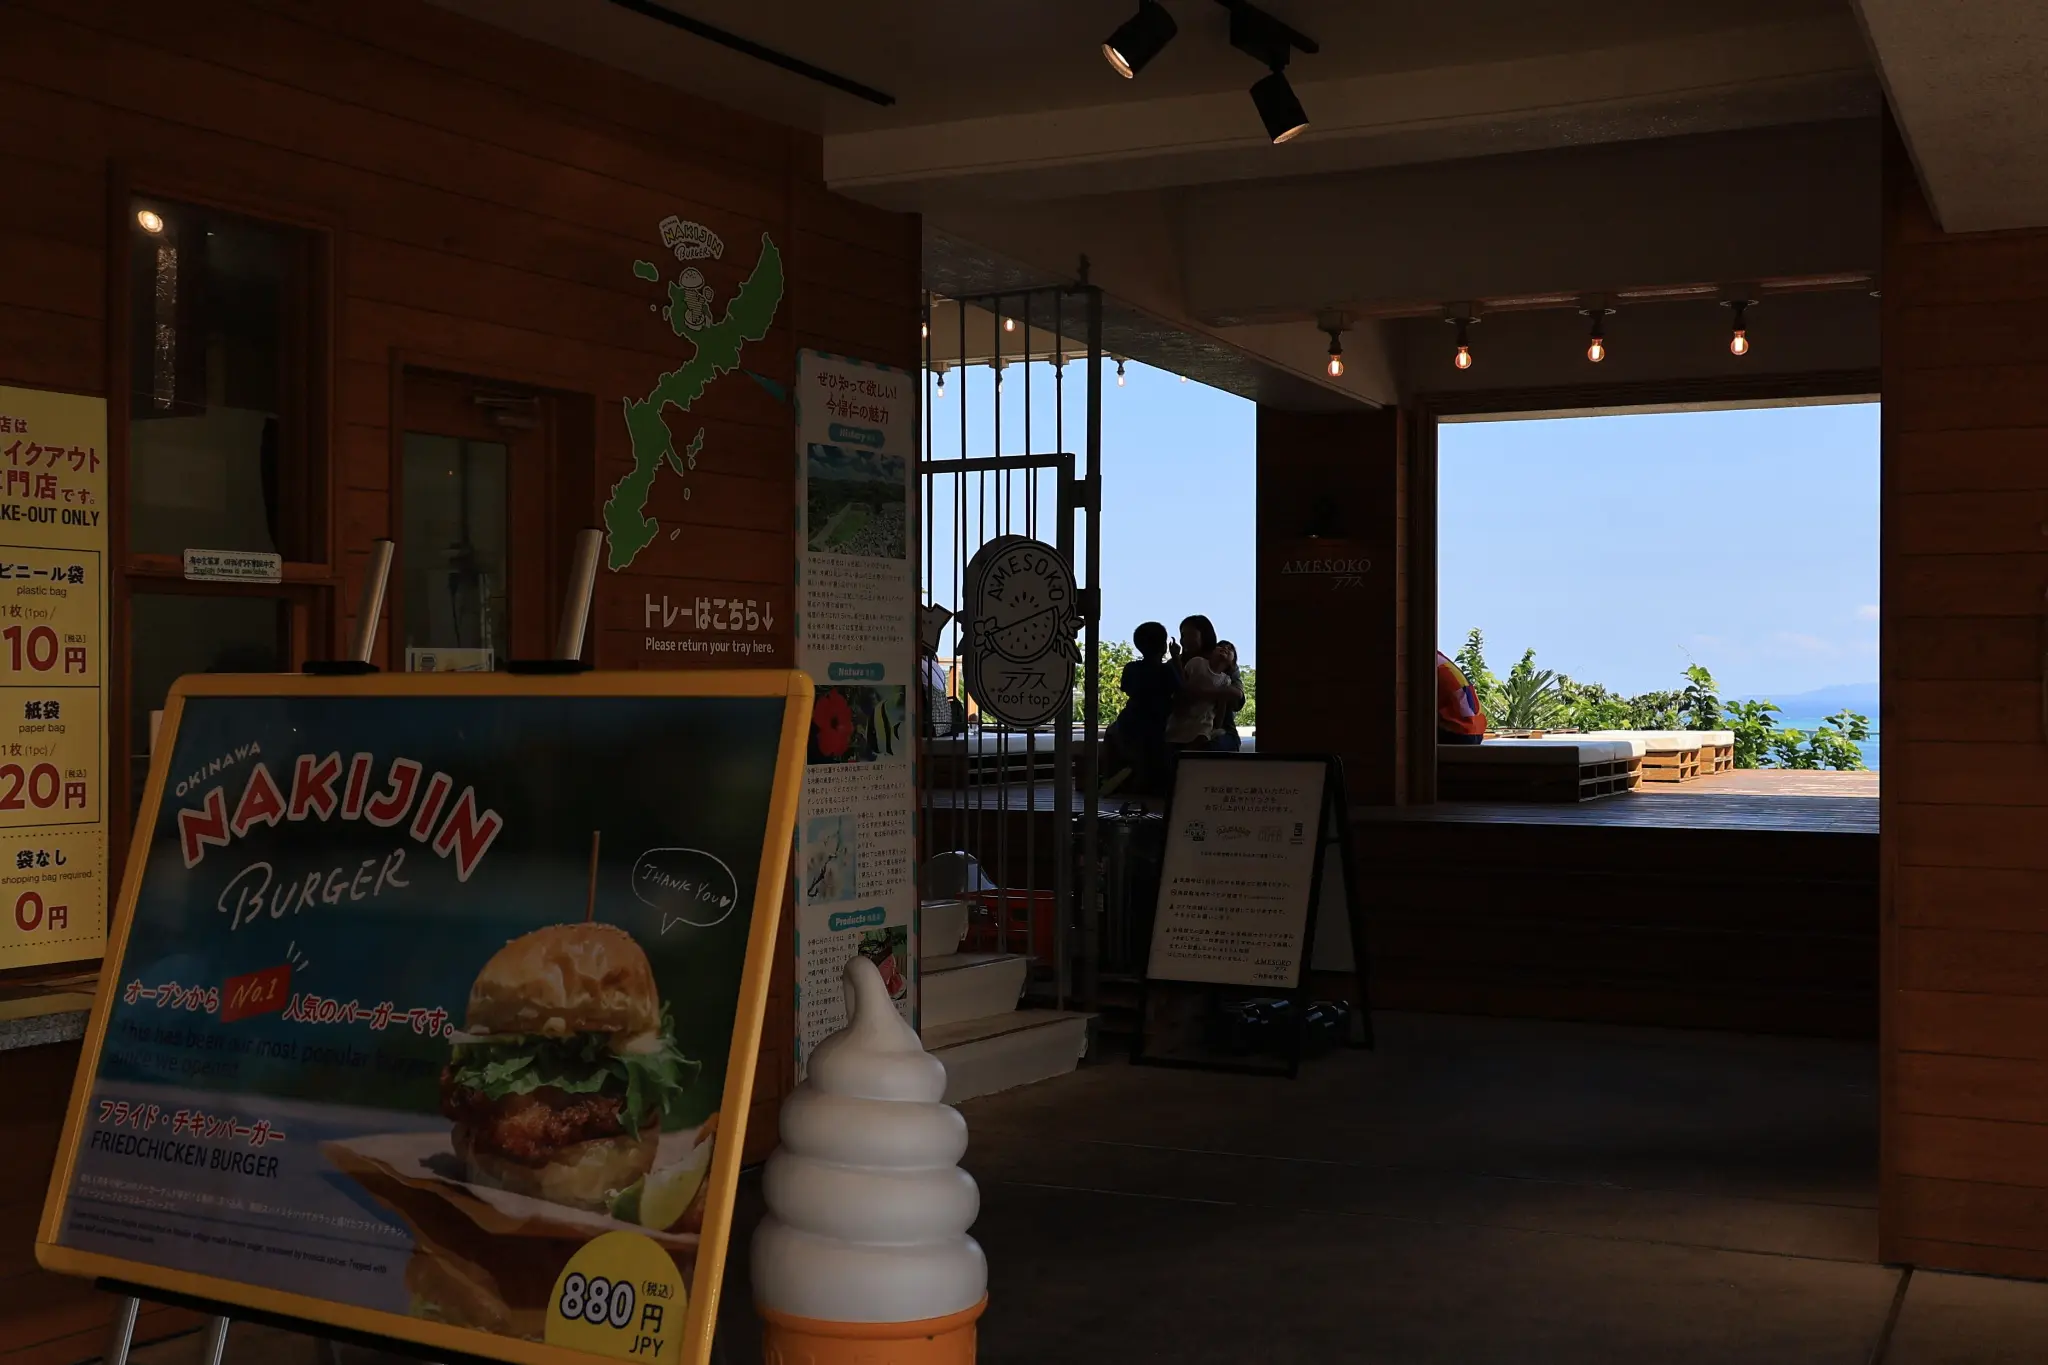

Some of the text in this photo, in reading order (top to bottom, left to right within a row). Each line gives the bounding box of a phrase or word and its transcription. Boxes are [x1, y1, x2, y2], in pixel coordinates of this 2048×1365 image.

[675, 244, 710, 259] BURGER
[0, 440, 101, 473] イクアウト
[62, 508, 99, 526] ONLY
[988, 553, 1064, 601] AMESOKO
[1281, 557, 1372, 574] AMESOKO
[16, 585, 67, 598] plastic bag
[645, 593, 759, 632] トレーはこちら
[645, 637, 774, 656] Please return your tray here.
[24, 700, 60, 720] 紙袋
[997, 692, 1050, 709] roof top
[19, 723, 65, 734] paper bag
[175, 740, 262, 797] OKINAWA
[177, 751, 503, 882] NAKIJIN
[16, 850, 66, 869] 袋なし
[2, 869, 93, 885] shopping bag required.
[217, 848, 411, 931] BURGER
[641, 862, 692, 893] THANK
[124, 977, 455, 1037] オープンから No.1 人気のバーガーです。
[186, 1025, 224, 1050] been
[256, 1038, 298, 1060] most
[99, 1100, 285, 1147] フライド・チキンバーガー
[91, 1130, 279, 1179] FRIEDCHICKEN BURGER
[629, 1334, 663, 1357] JPY
